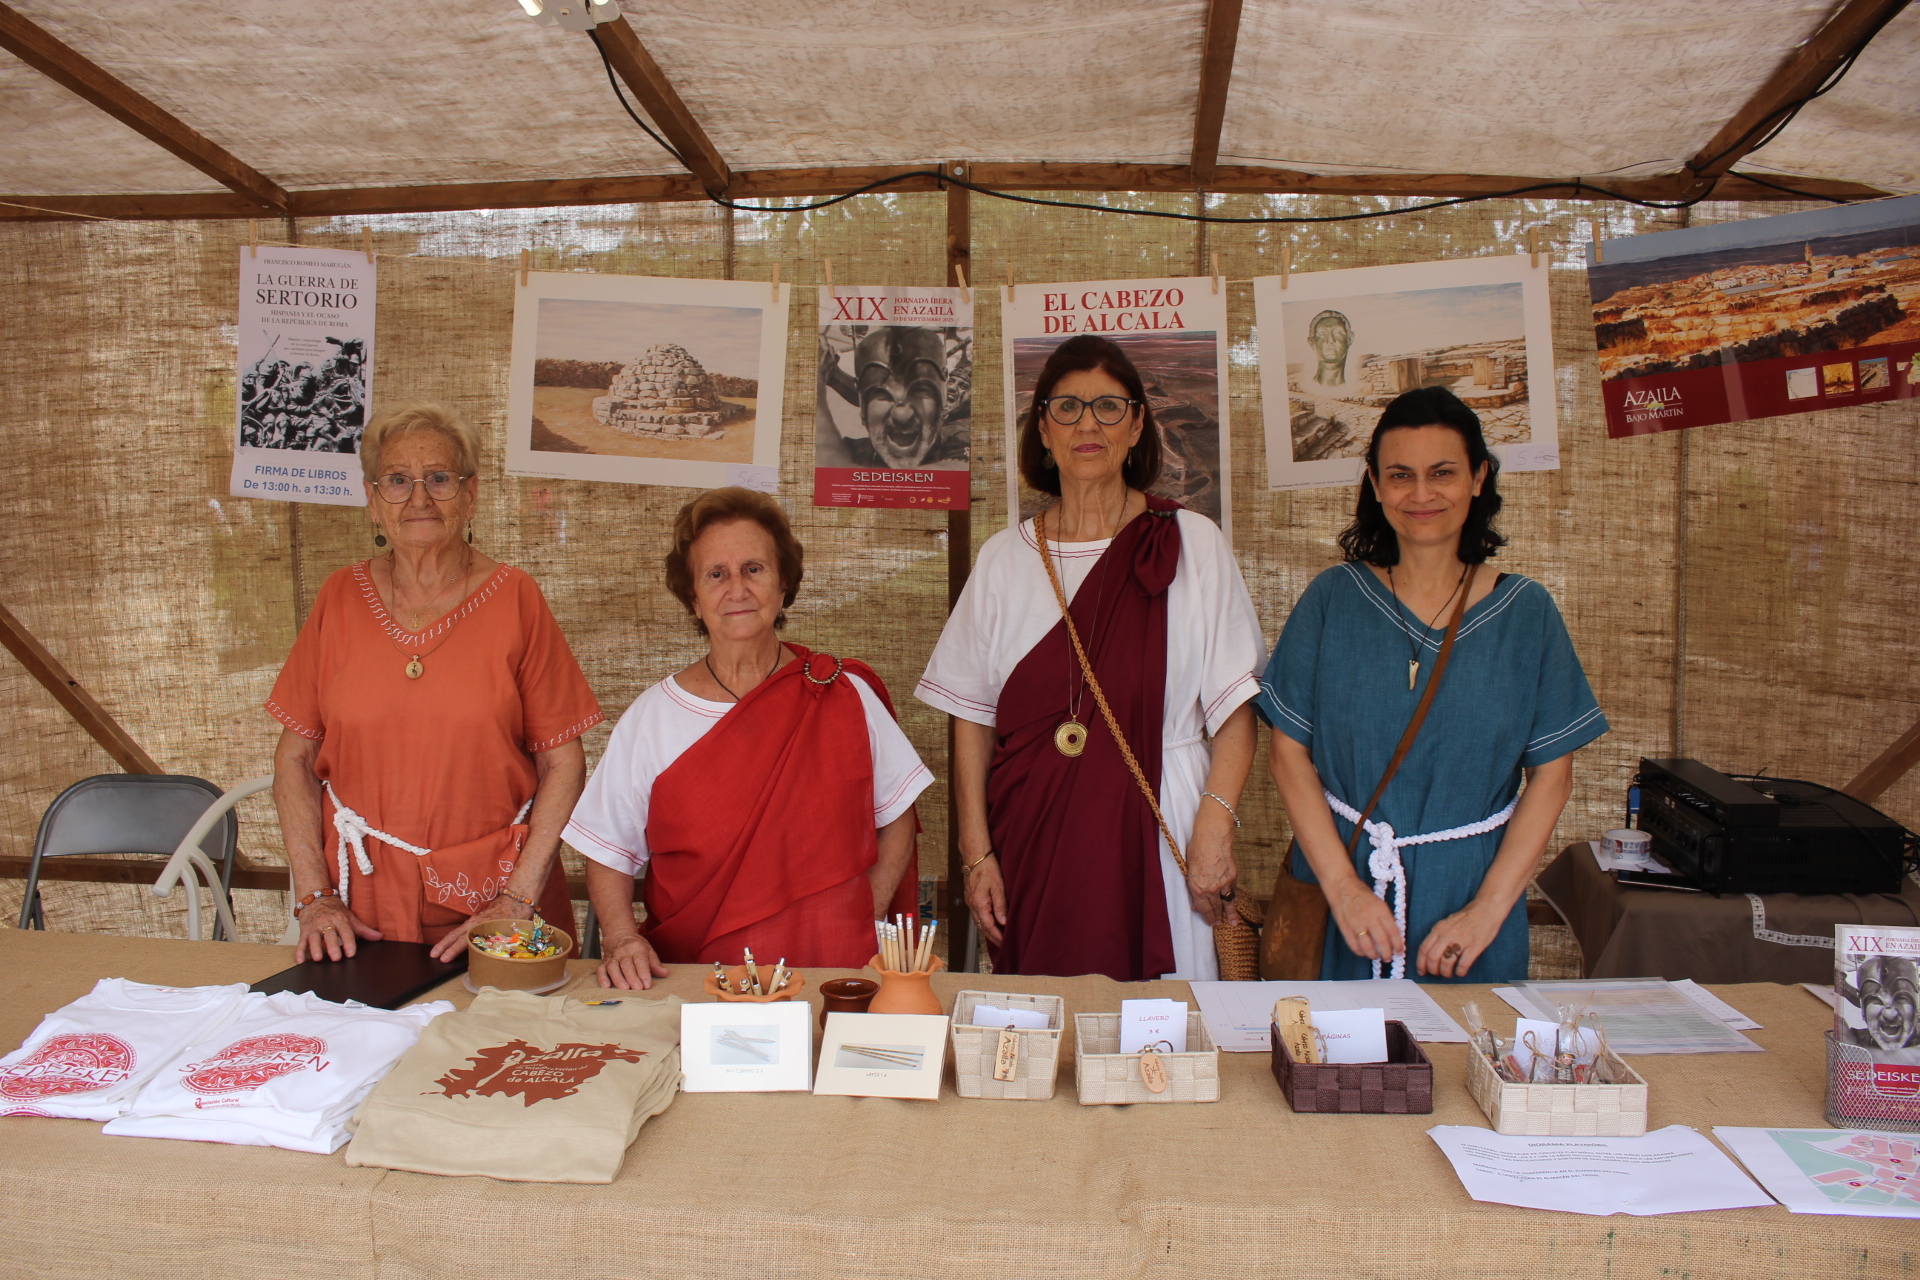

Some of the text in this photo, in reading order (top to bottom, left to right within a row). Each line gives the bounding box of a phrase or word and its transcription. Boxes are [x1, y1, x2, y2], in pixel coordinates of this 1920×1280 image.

[263, 258, 296, 266] FRANCISCO
[320, 261, 352, 269] MARUGÁN
[257, 273, 359, 290] LA GUERRA DE
[255, 288, 358, 310] SERTORIO
[930, 295, 953, 305] ÍBERA
[1043, 288, 1184, 312] EL CABEZO
[270, 309, 301, 318] HISPANIA
[832, 296, 889, 320] XIX
[893, 305, 954, 316] EN AZAILA
[281, 317, 318, 326] REPÚBLICA
[329, 320, 349, 328] ROMA
[1043, 311, 1185, 334] DE ALCALA
[1623, 386, 1682, 408] AZAILA
[1626, 407, 1684, 423] BAJO MARTÍN
[254, 465, 347, 481] FIRMA DE LIBROS
[851, 471, 934, 483] SEDEISKEN
[243, 479, 353, 496] De 13:00 h. a 13:30 h.
[1848, 935, 1885, 953] XIX
[511, 1069, 565, 1077] CABEZO
[524, 1075, 576, 1084] ALCALÁ
[1846, 1070, 1920, 1083] SEDEISKE
